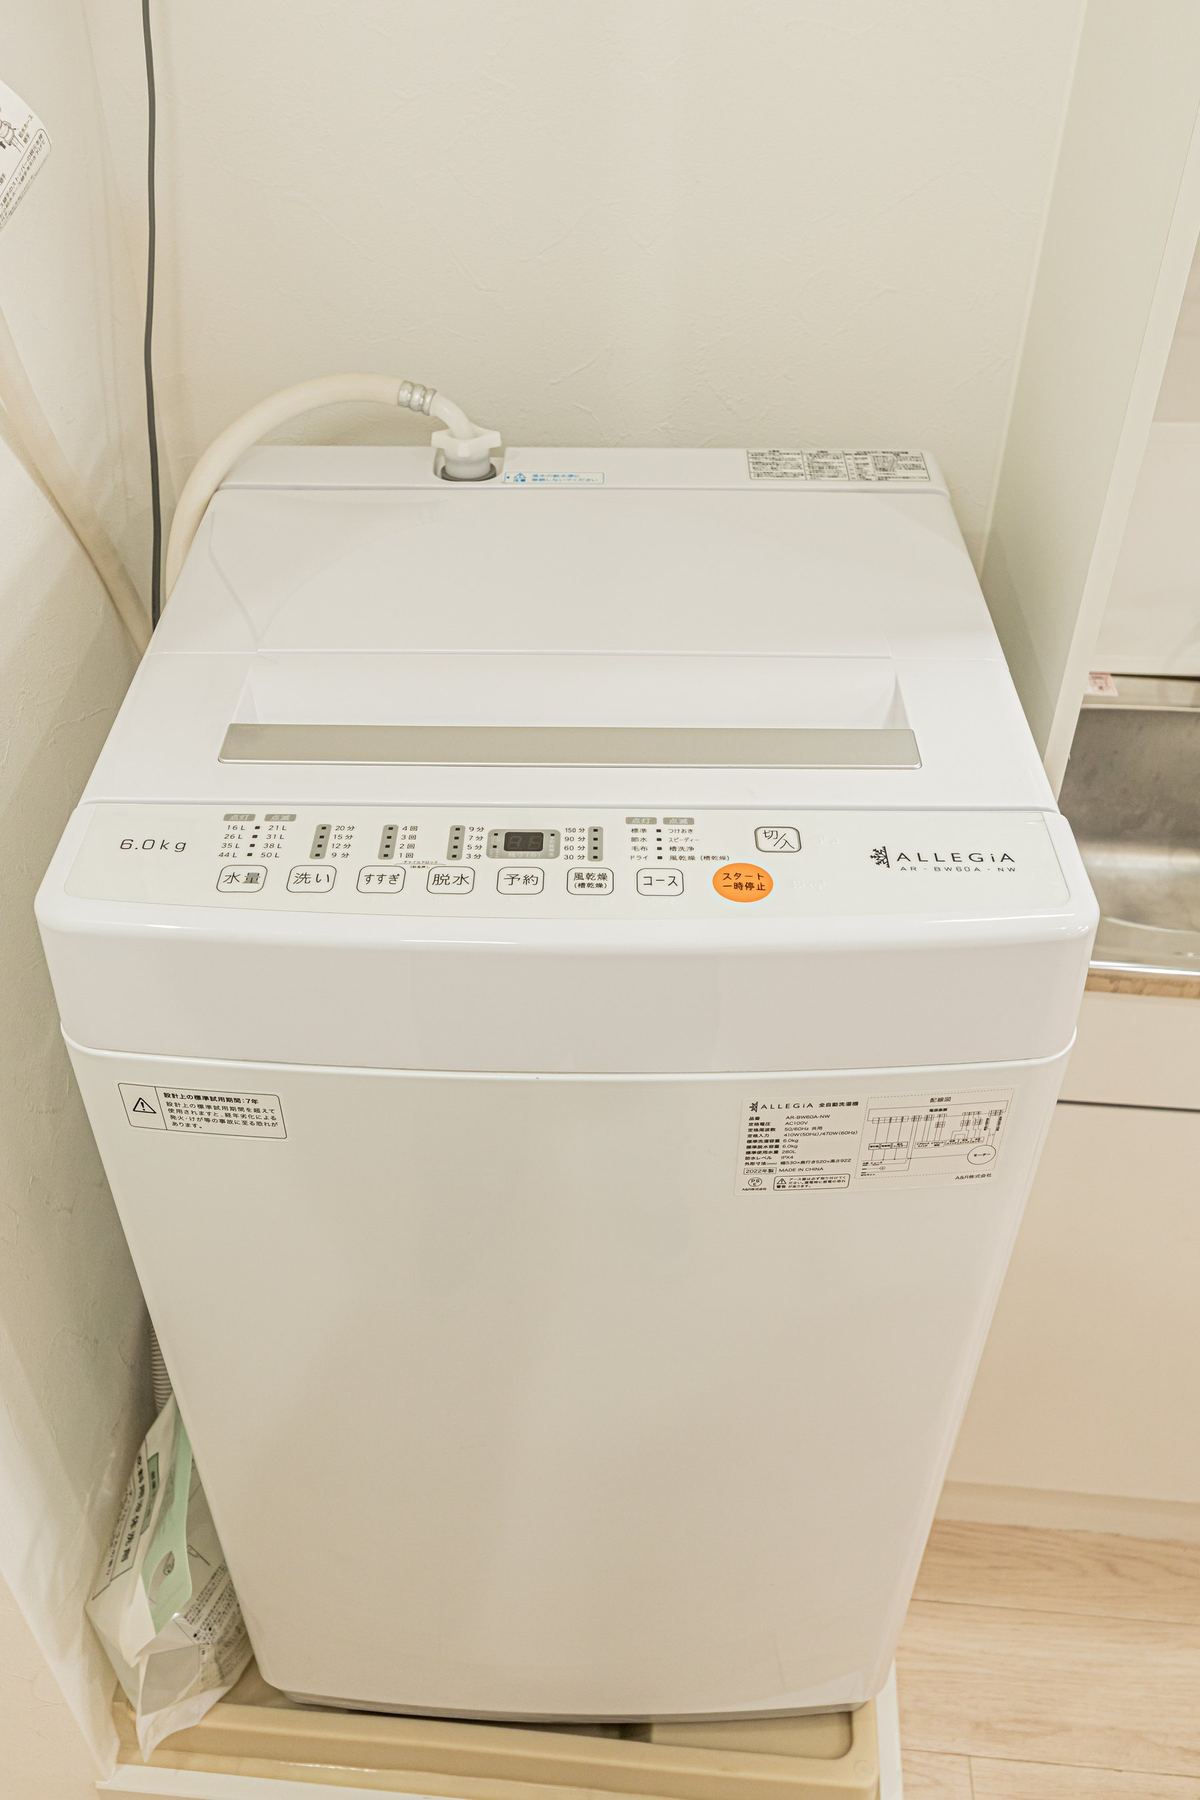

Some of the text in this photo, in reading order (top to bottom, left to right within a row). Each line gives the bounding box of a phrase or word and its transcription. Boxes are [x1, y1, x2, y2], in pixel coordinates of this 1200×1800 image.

[120, 838, 187, 853] 6.0kg
[223, 872, 261, 885] 水量
[293, 872, 331, 885] 洗い
[363, 873, 401, 885] すすぎ
[432, 873, 470, 886] 脱水
[503, 873, 539, 886] 予約
[574, 872, 608, 881] 風乾燥
[643, 876, 678, 887] コース
[723, 872, 765, 881] スタート
[722, 882, 766, 892] 一時停止
